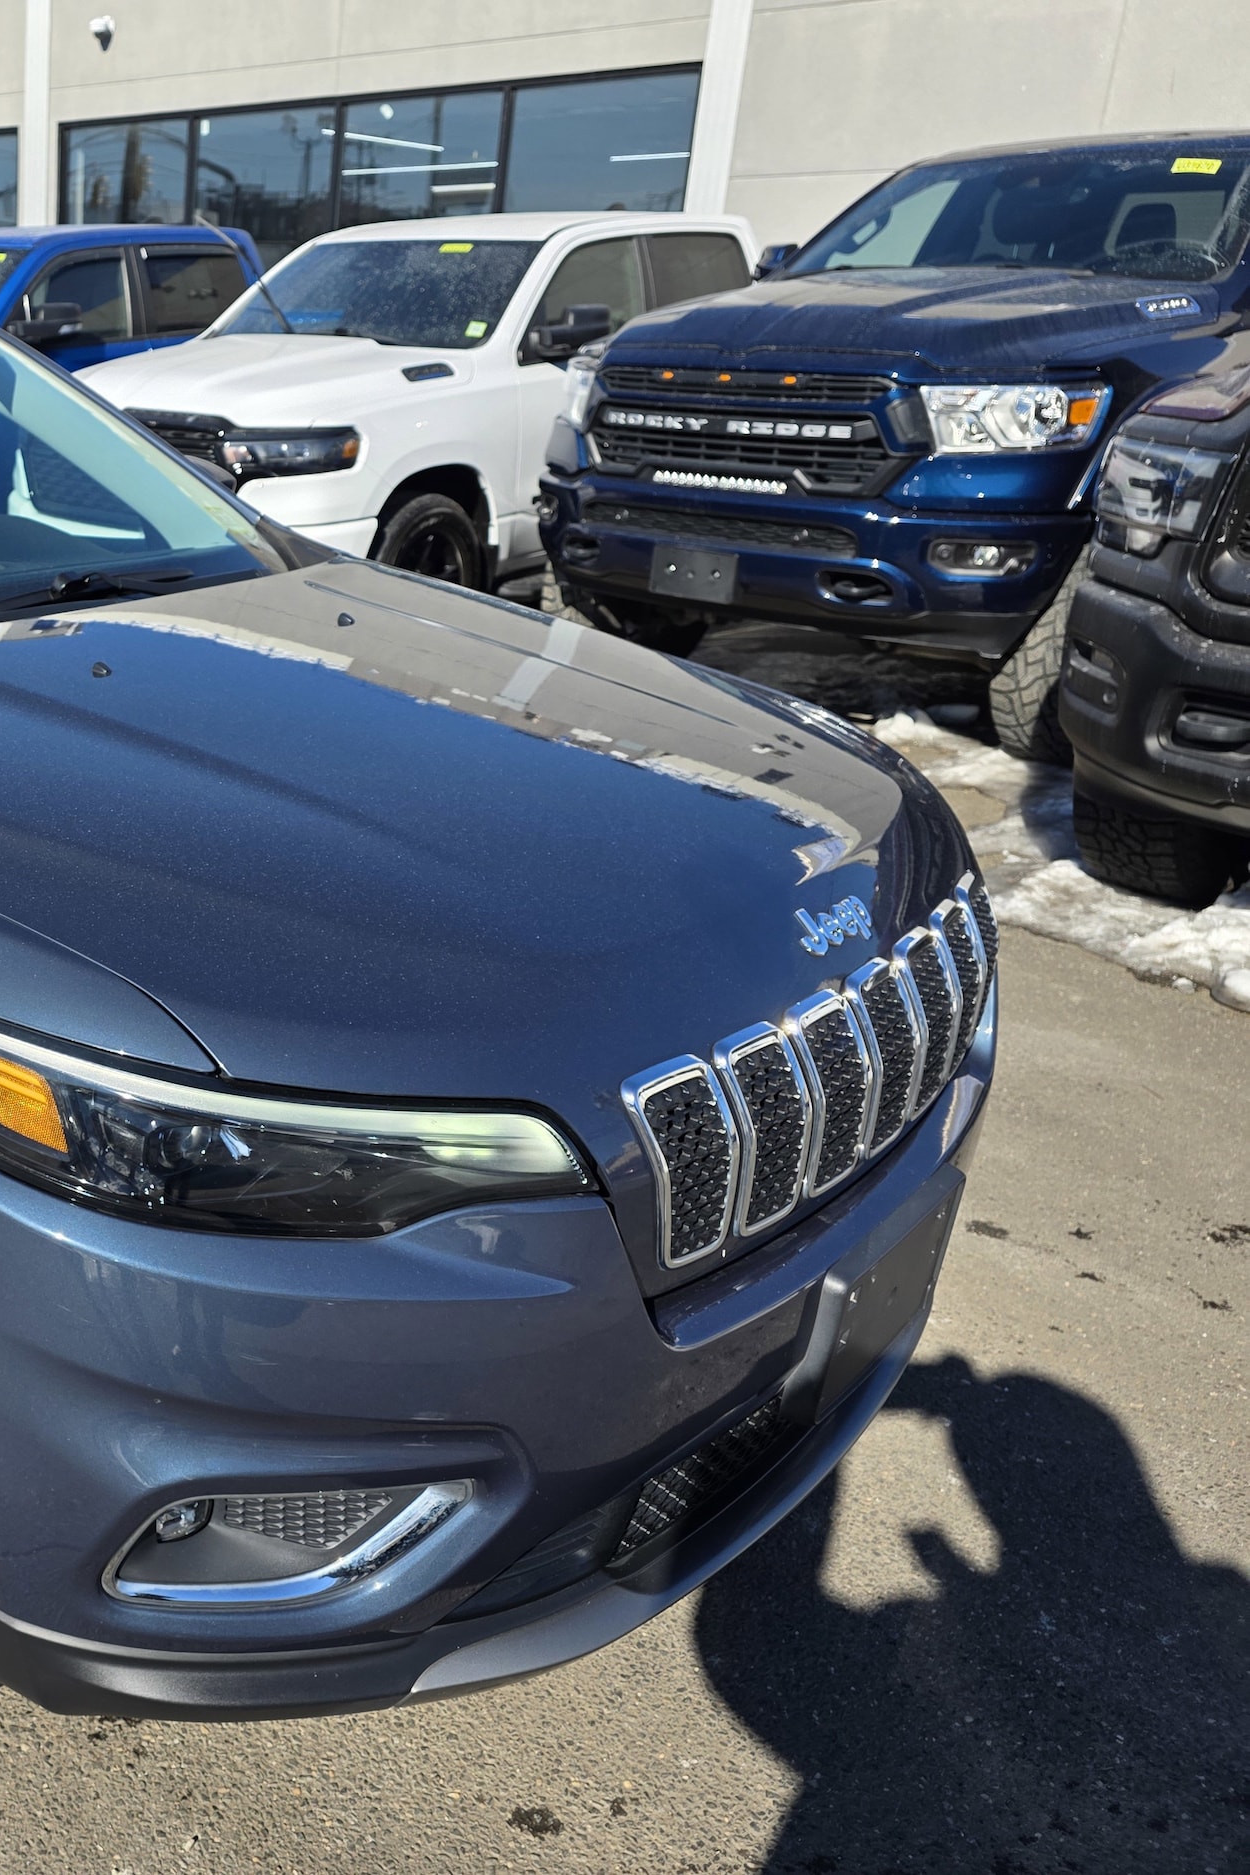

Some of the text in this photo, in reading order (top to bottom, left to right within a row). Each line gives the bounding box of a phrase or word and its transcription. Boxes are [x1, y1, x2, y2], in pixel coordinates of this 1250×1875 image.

[607, 411, 852, 439] ROCKY RIDGE
[794, 895, 872, 956] Jeep
